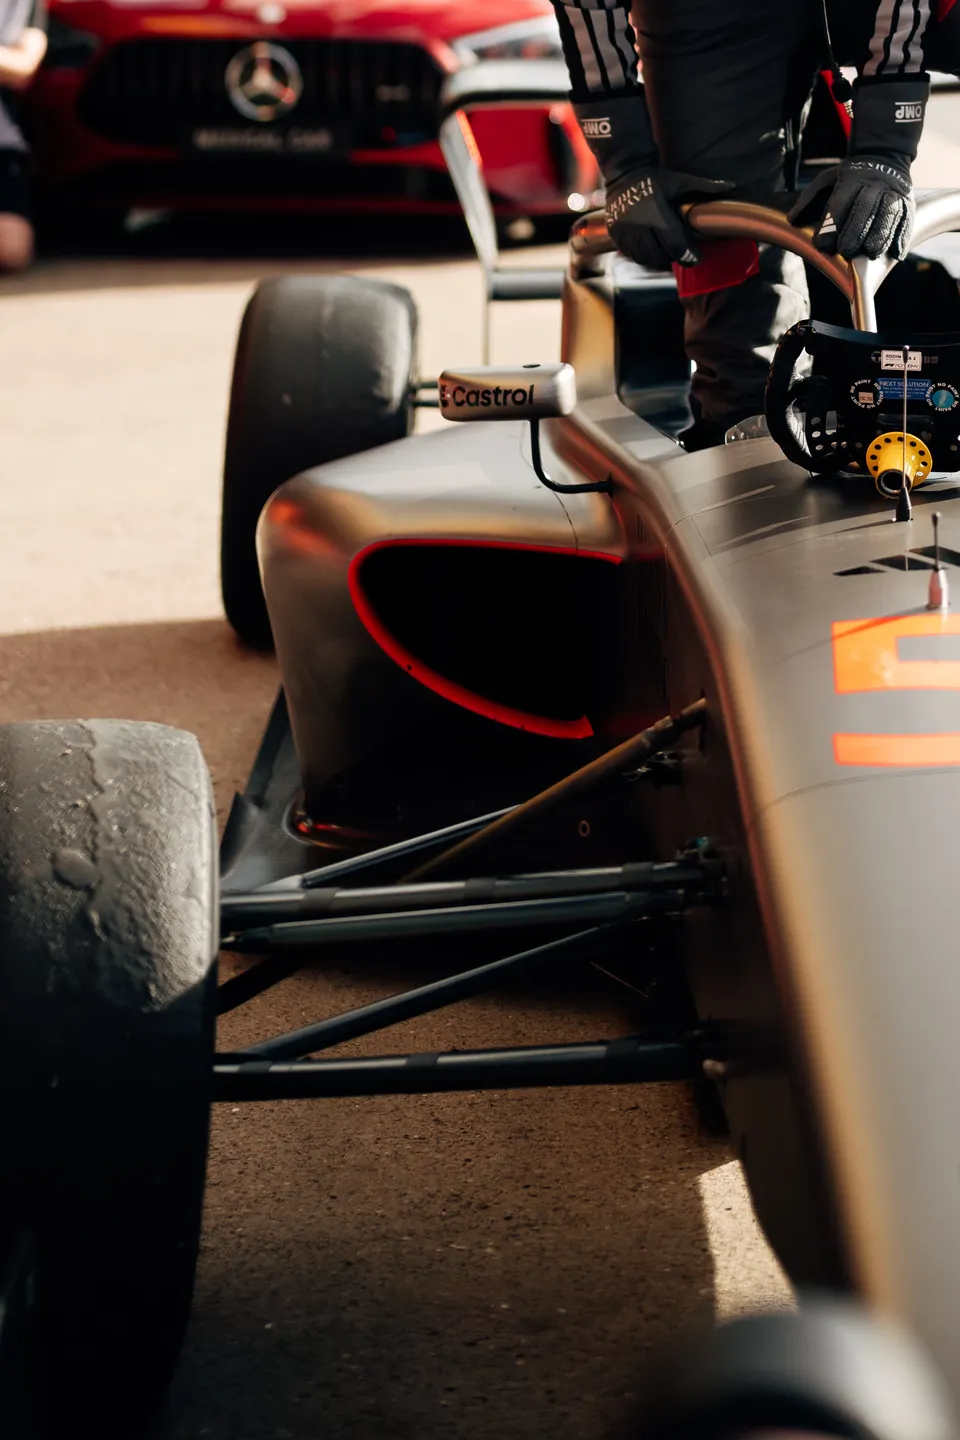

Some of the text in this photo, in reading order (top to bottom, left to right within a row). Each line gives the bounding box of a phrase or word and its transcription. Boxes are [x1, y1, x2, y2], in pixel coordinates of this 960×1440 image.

[894, 103, 922, 121] OMP
[582, 120, 612, 136] OMP
[452, 384, 535, 408] Castrol
